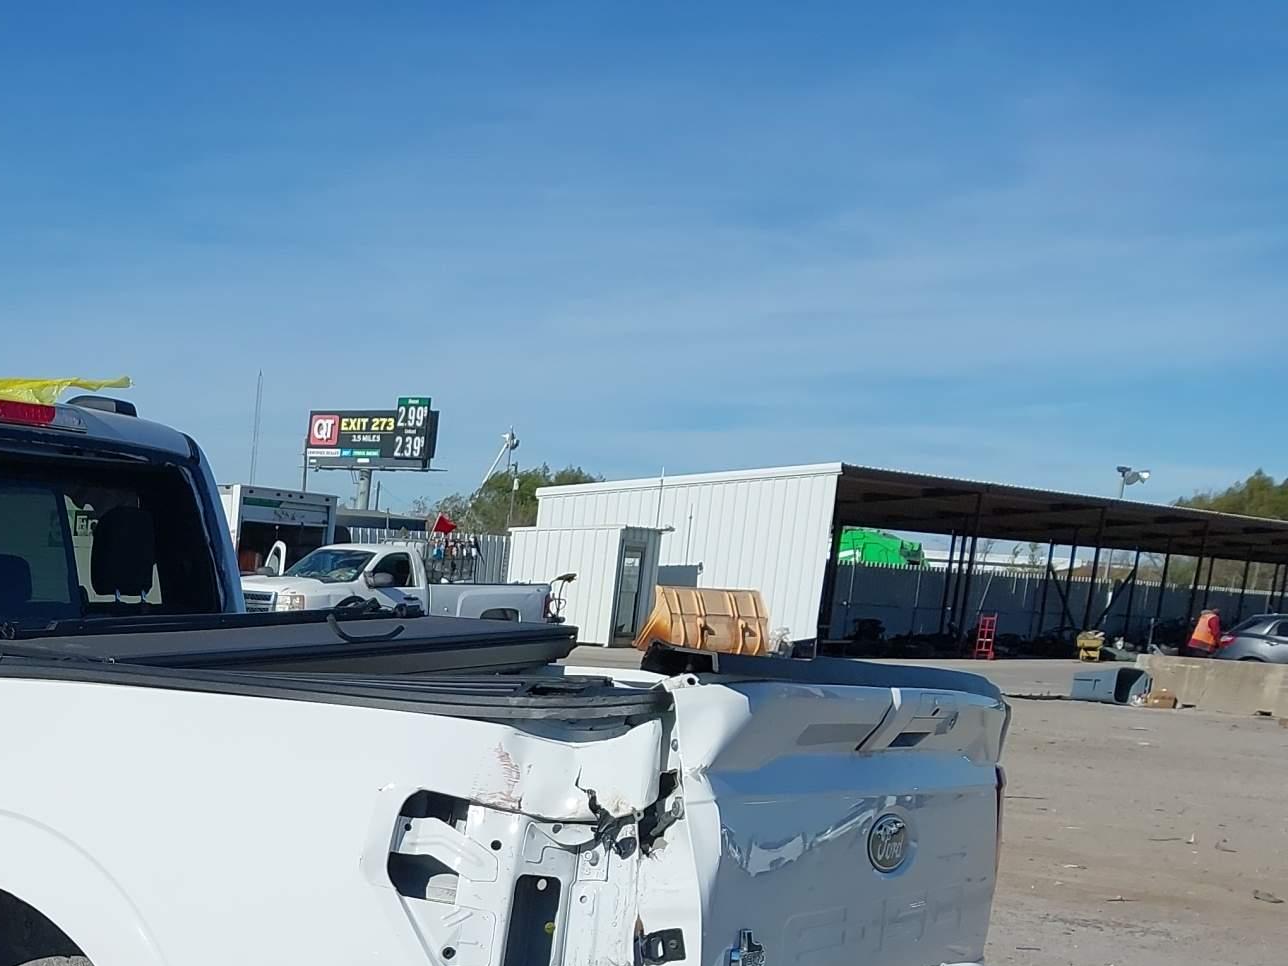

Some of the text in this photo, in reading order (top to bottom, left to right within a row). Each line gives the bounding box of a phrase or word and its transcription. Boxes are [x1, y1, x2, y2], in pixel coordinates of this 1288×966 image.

[313, 419, 335, 440] QT
[340, 418, 395, 431] EXIT 273
